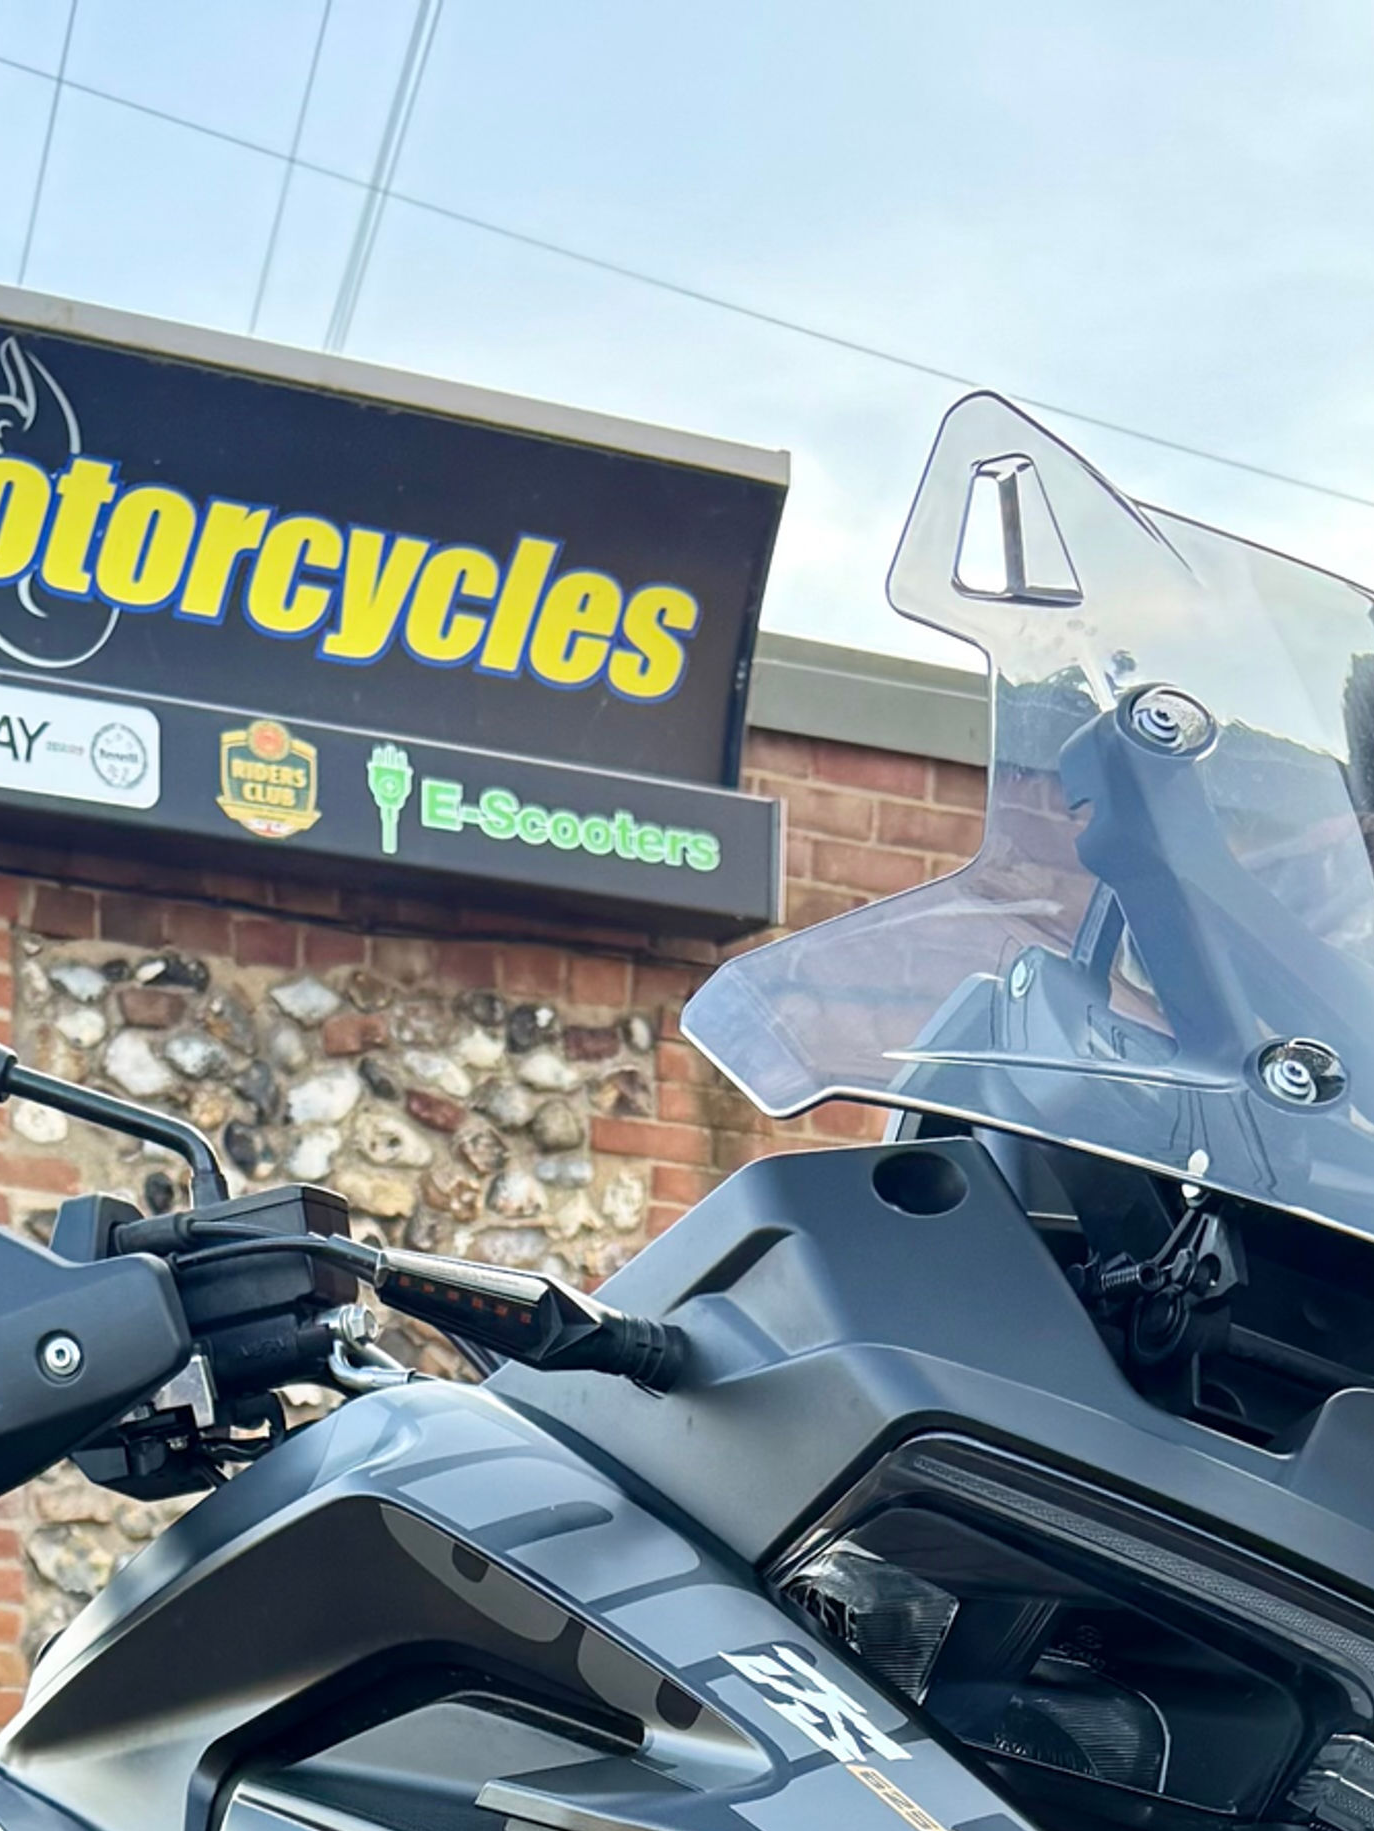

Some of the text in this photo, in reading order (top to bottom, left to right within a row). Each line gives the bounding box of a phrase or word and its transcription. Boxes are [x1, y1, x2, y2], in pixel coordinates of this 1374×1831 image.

[230, 757, 308, 789] RIDERS
[241, 781, 296, 807] CLUB
[421, 778, 722, 872] E-Scooters
